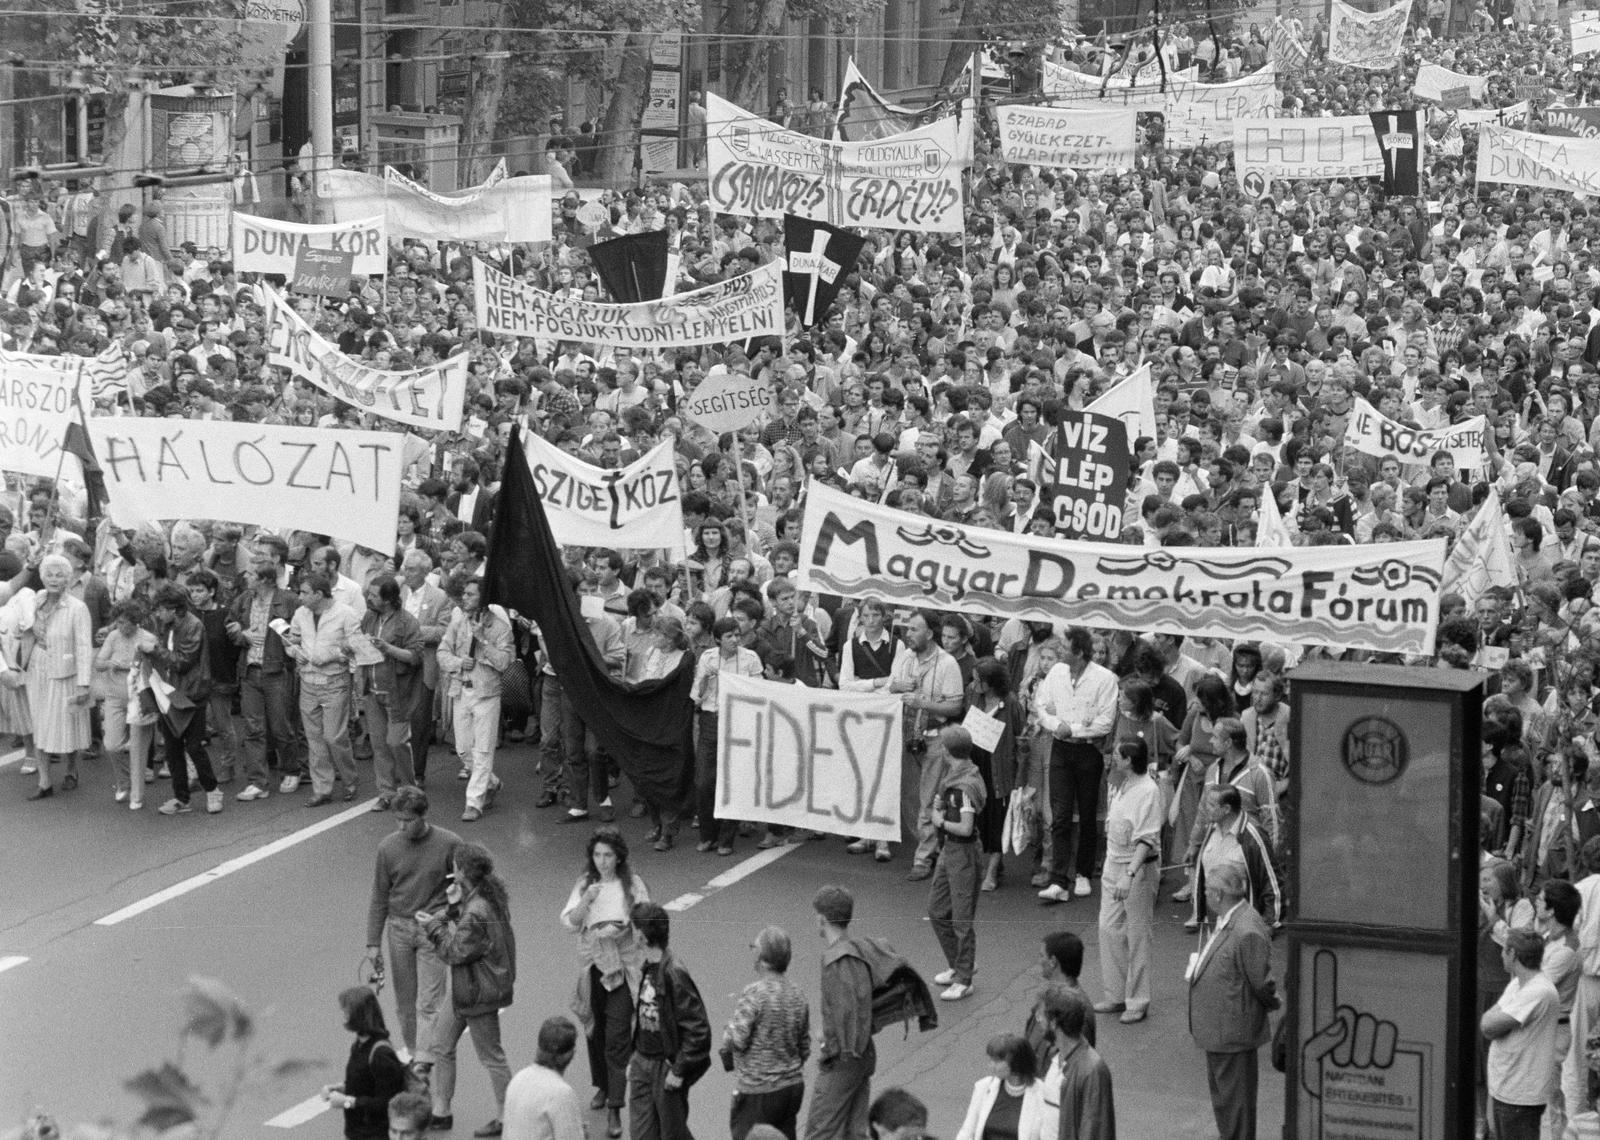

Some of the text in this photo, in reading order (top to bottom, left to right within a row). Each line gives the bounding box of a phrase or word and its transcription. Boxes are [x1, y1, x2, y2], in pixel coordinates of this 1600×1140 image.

[1006, 111, 1067, 129] SZABAD
[1551, 143, 1569, 166] A
[244, 223, 381, 257] DUNA KÖR
[693, 386, 771, 416] SEGÍTSÉG
[1063, 413, 1109, 454] VÍZ
[105, 429, 392, 502] HÁLÓZAT
[1058, 453, 1115, 491] LÉP
[811, 511, 1429, 624] Magyar Demokrata Fórum
[722, 691, 896, 826] FIDESZ
